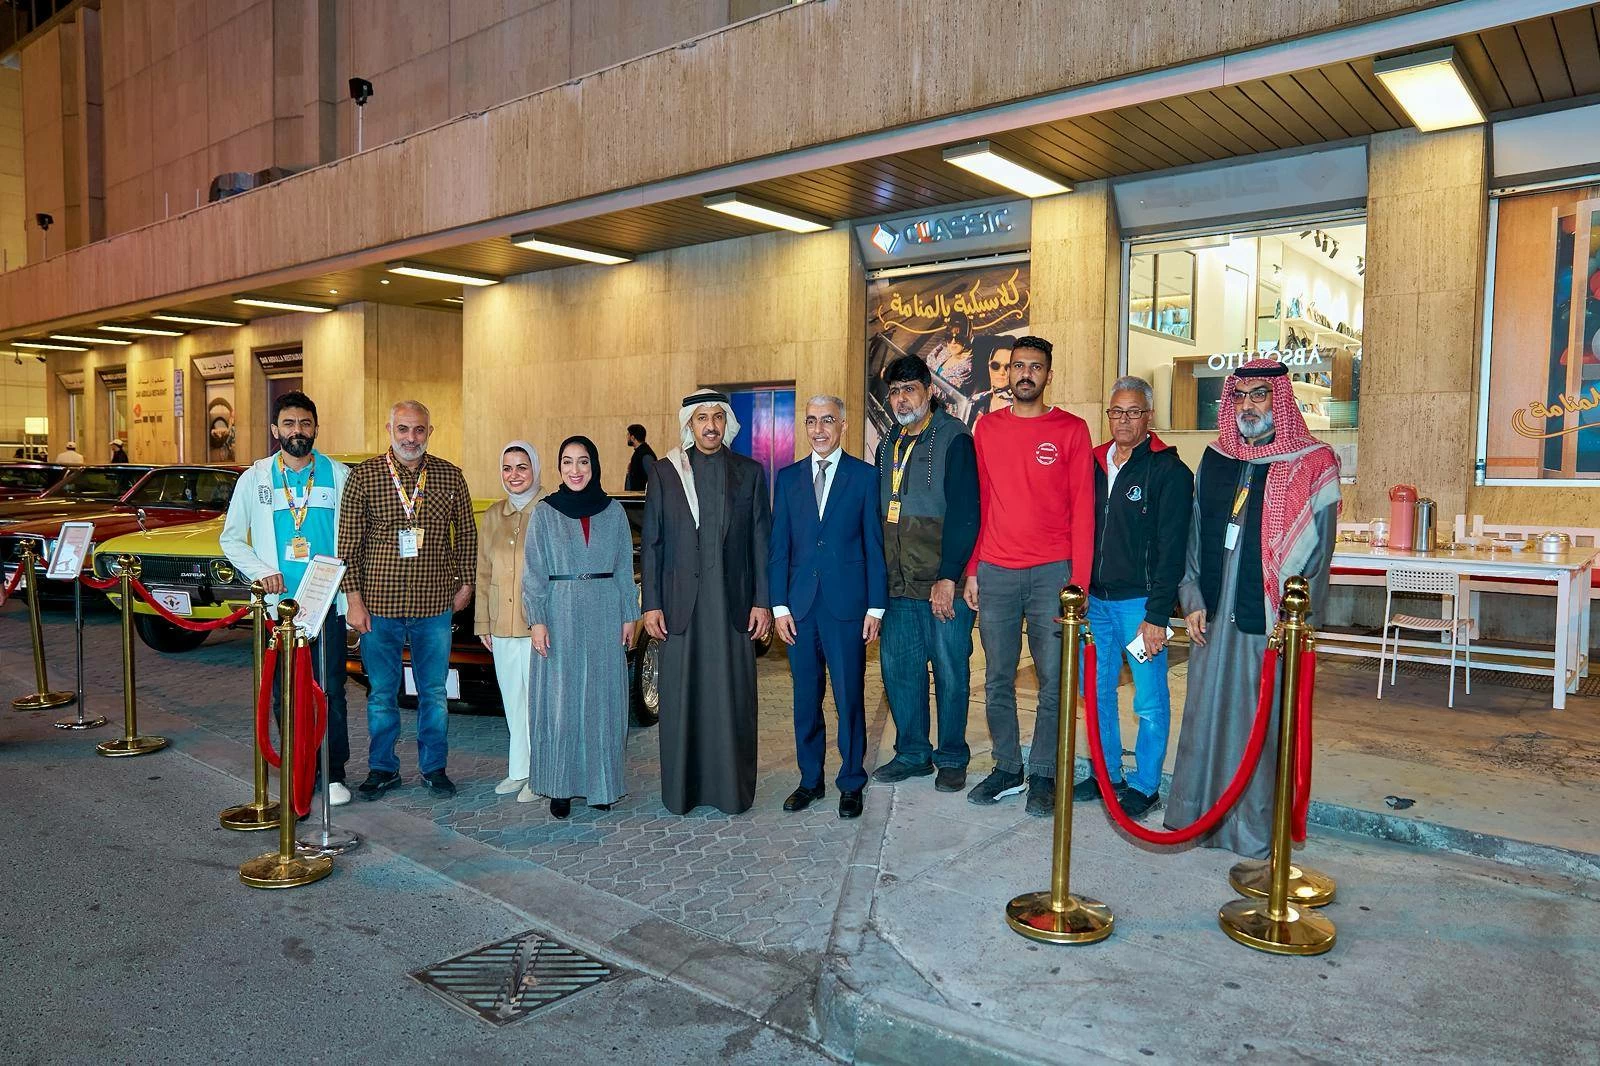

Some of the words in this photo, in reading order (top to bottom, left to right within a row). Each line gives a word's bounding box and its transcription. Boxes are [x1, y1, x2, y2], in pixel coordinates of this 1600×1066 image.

[904, 208, 1012, 244] CLASSIC
[954, 268, 1020, 320] كلاسيكية
[1529, 387, 1600, 418] لمنامة
